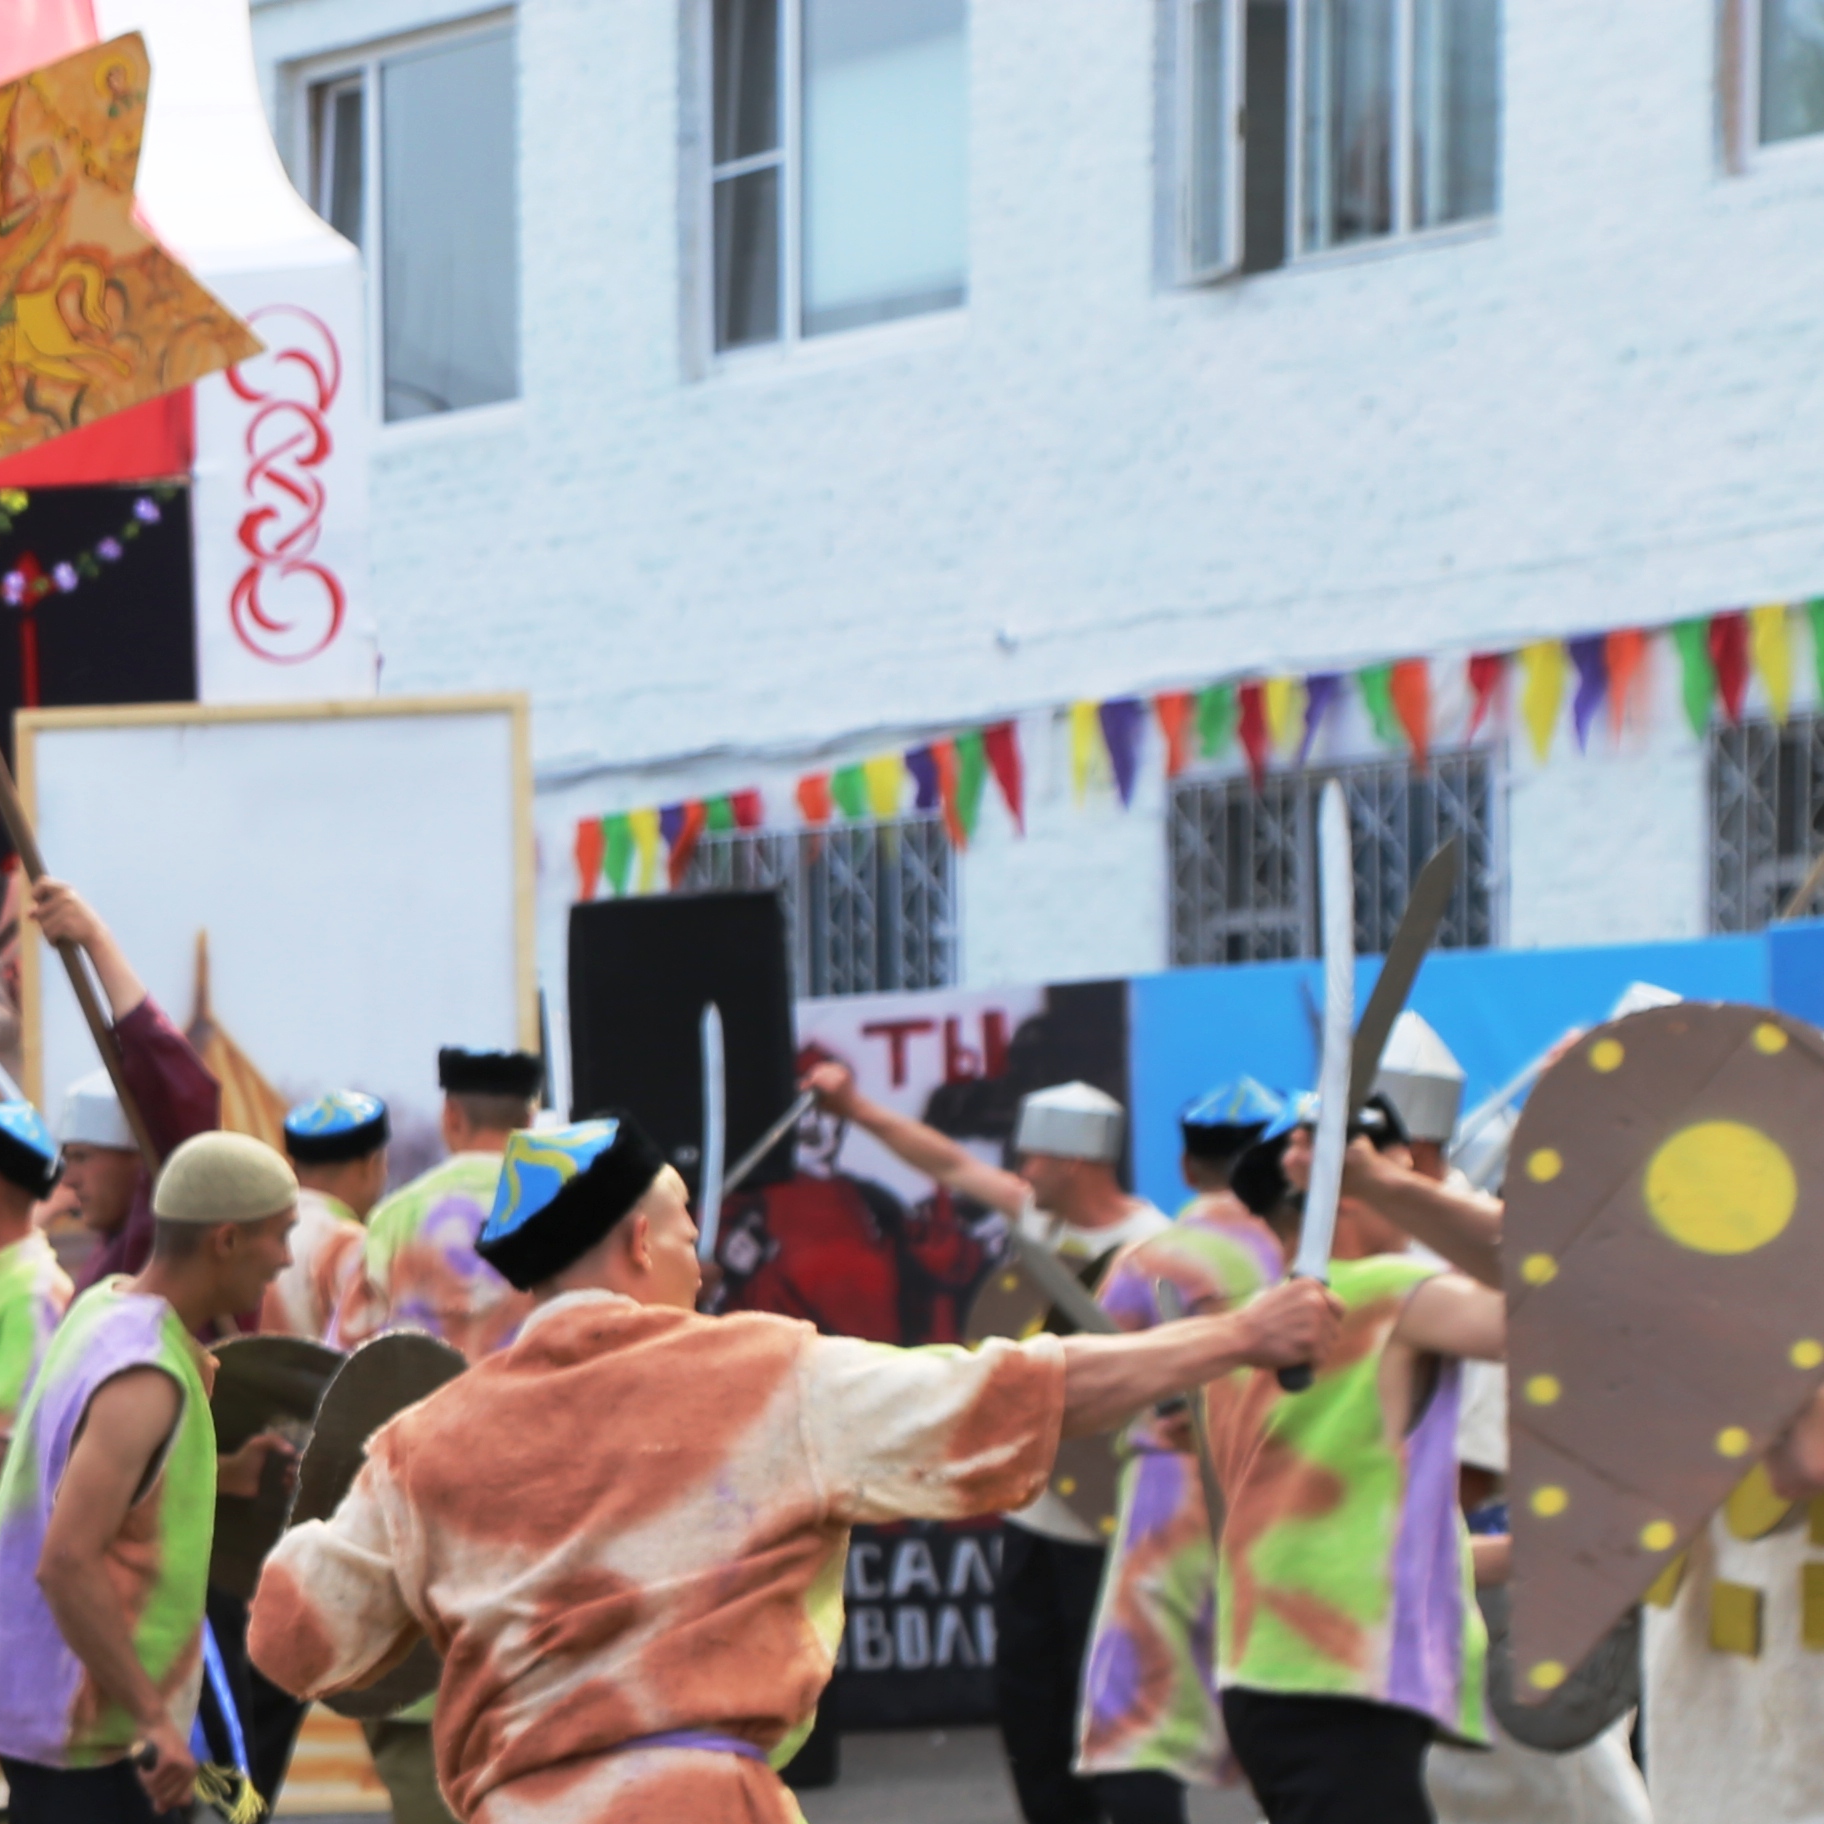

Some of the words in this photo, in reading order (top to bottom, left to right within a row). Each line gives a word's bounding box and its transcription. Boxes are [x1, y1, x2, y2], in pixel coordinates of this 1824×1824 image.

[861, 1010, 1008, 1088] ТЫ
[844, 1534, 1004, 1598] САЛ
[836, 1602, 999, 1672] ВОЛ
